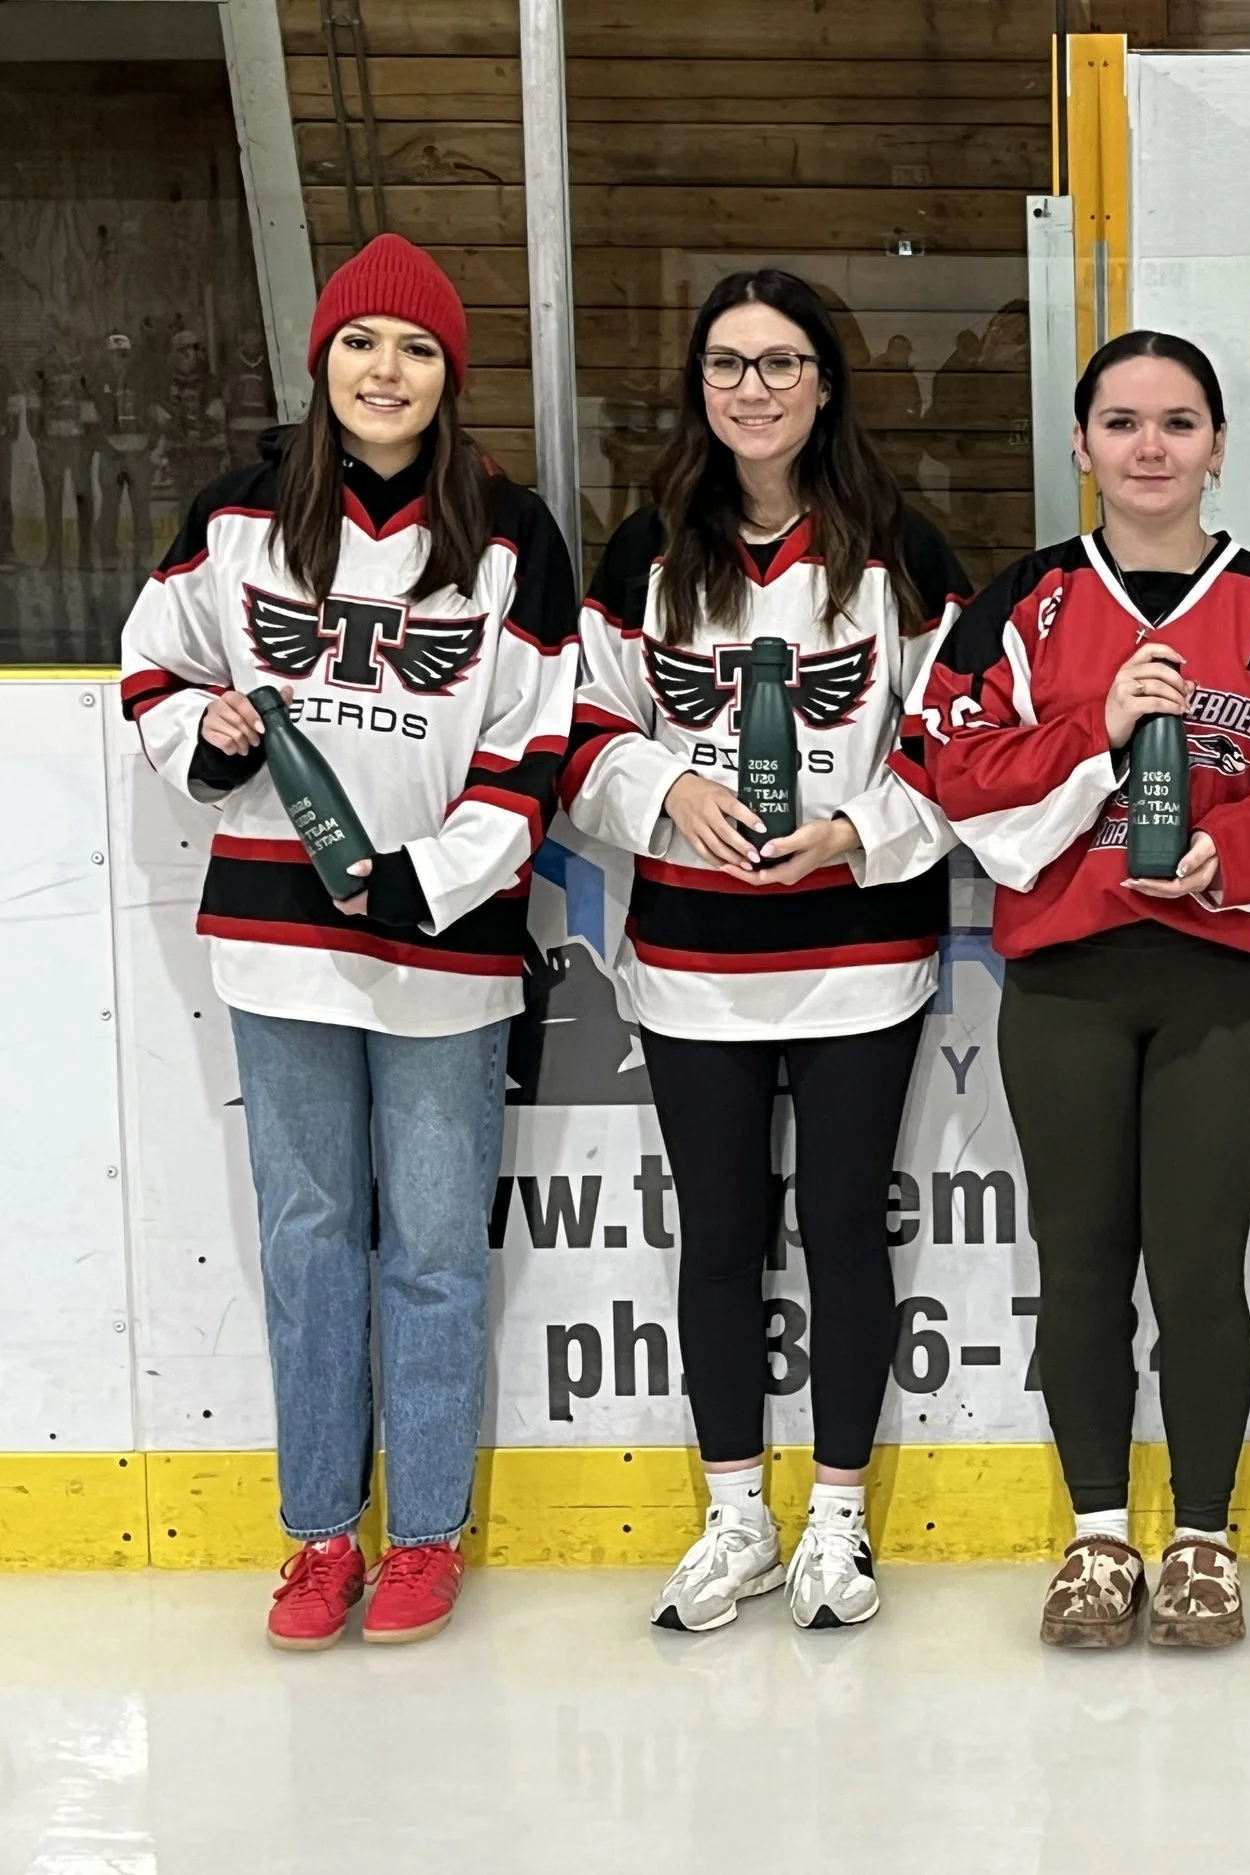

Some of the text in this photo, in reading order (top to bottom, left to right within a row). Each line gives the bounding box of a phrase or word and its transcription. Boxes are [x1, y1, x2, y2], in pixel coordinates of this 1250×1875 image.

[691, 743, 835, 774] BIS
[748, 759, 779, 771] 2026
[749, 772, 776, 785] U20
[1142, 771, 1172, 783] 2026
[1143, 784, 1169, 797] U20
[304, 817, 339, 840] TEAM
[315, 829, 345, 851] STAR
